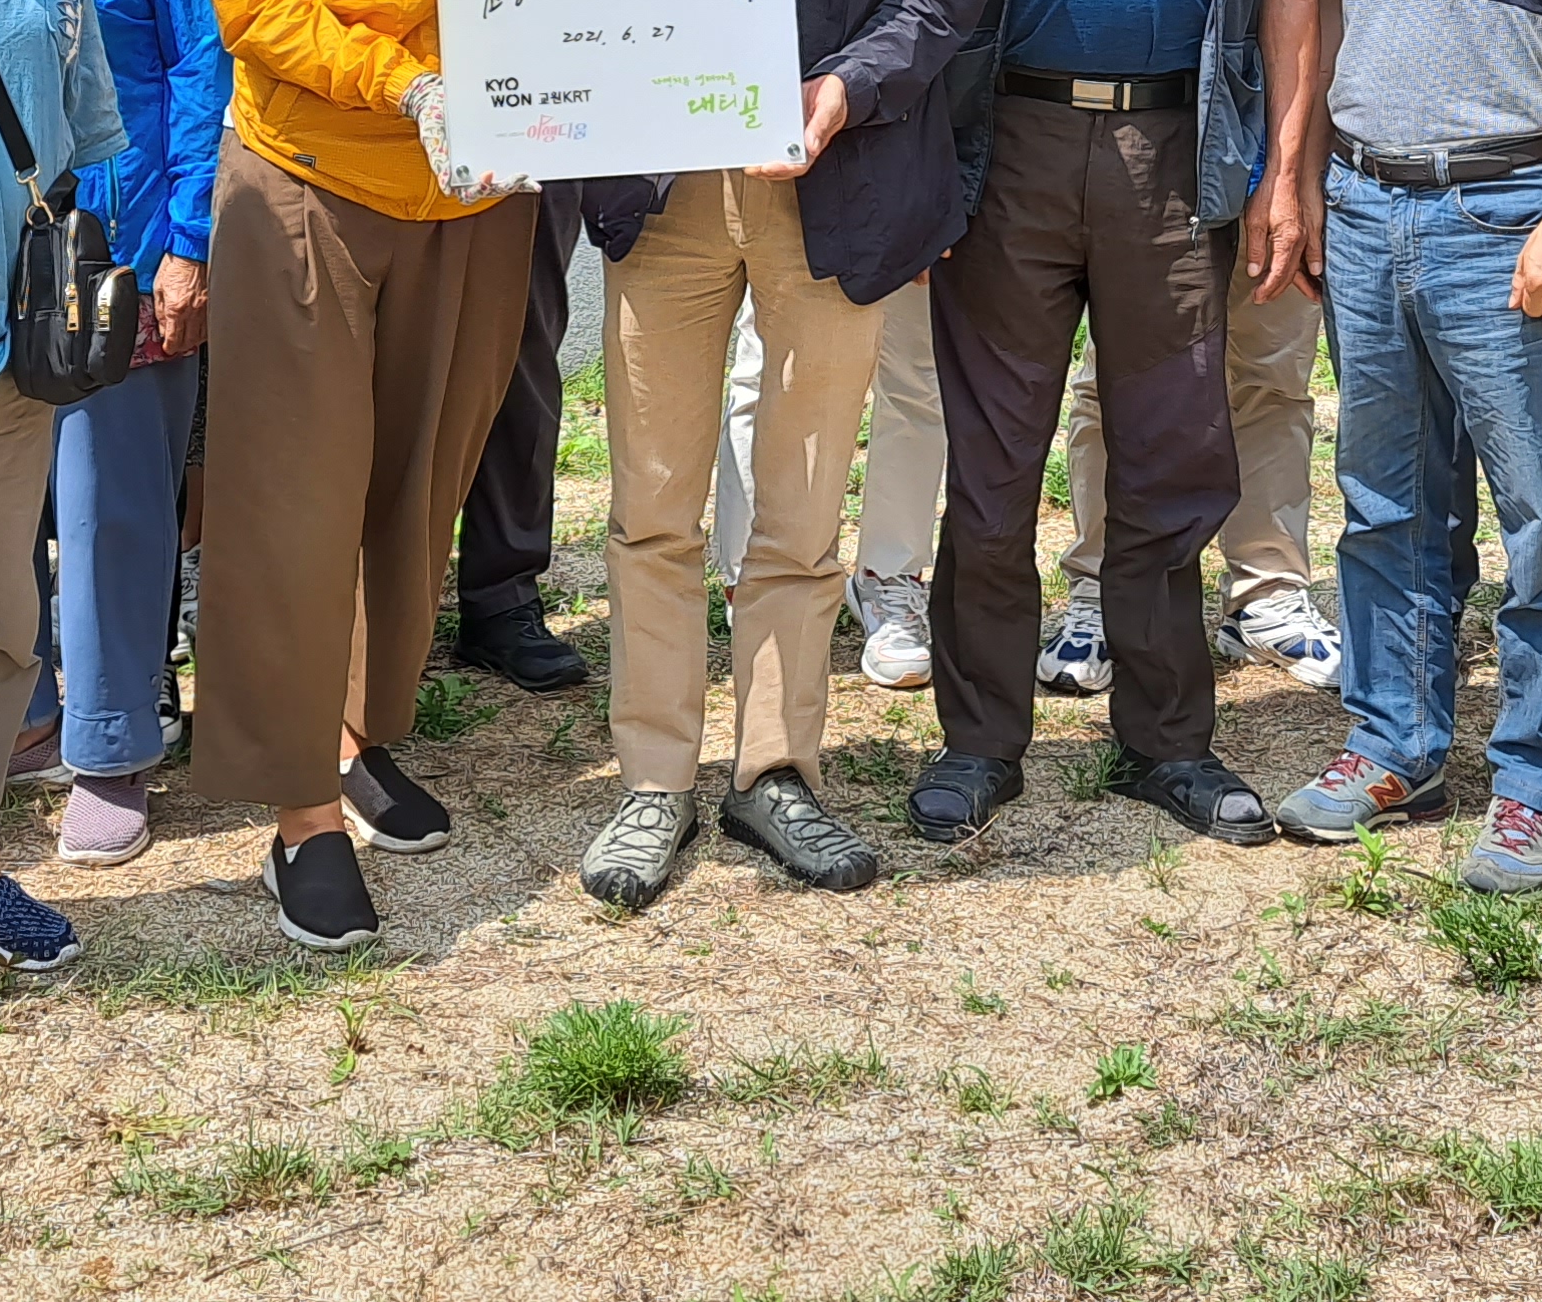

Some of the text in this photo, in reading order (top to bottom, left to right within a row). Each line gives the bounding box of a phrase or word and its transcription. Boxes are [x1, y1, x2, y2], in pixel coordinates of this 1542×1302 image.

[651, 24, 676, 42] 27
[485, 76, 519, 92] KYO
[490, 89, 592, 109] WON 교원KRT
[686, 84, 764, 131] 대티골
